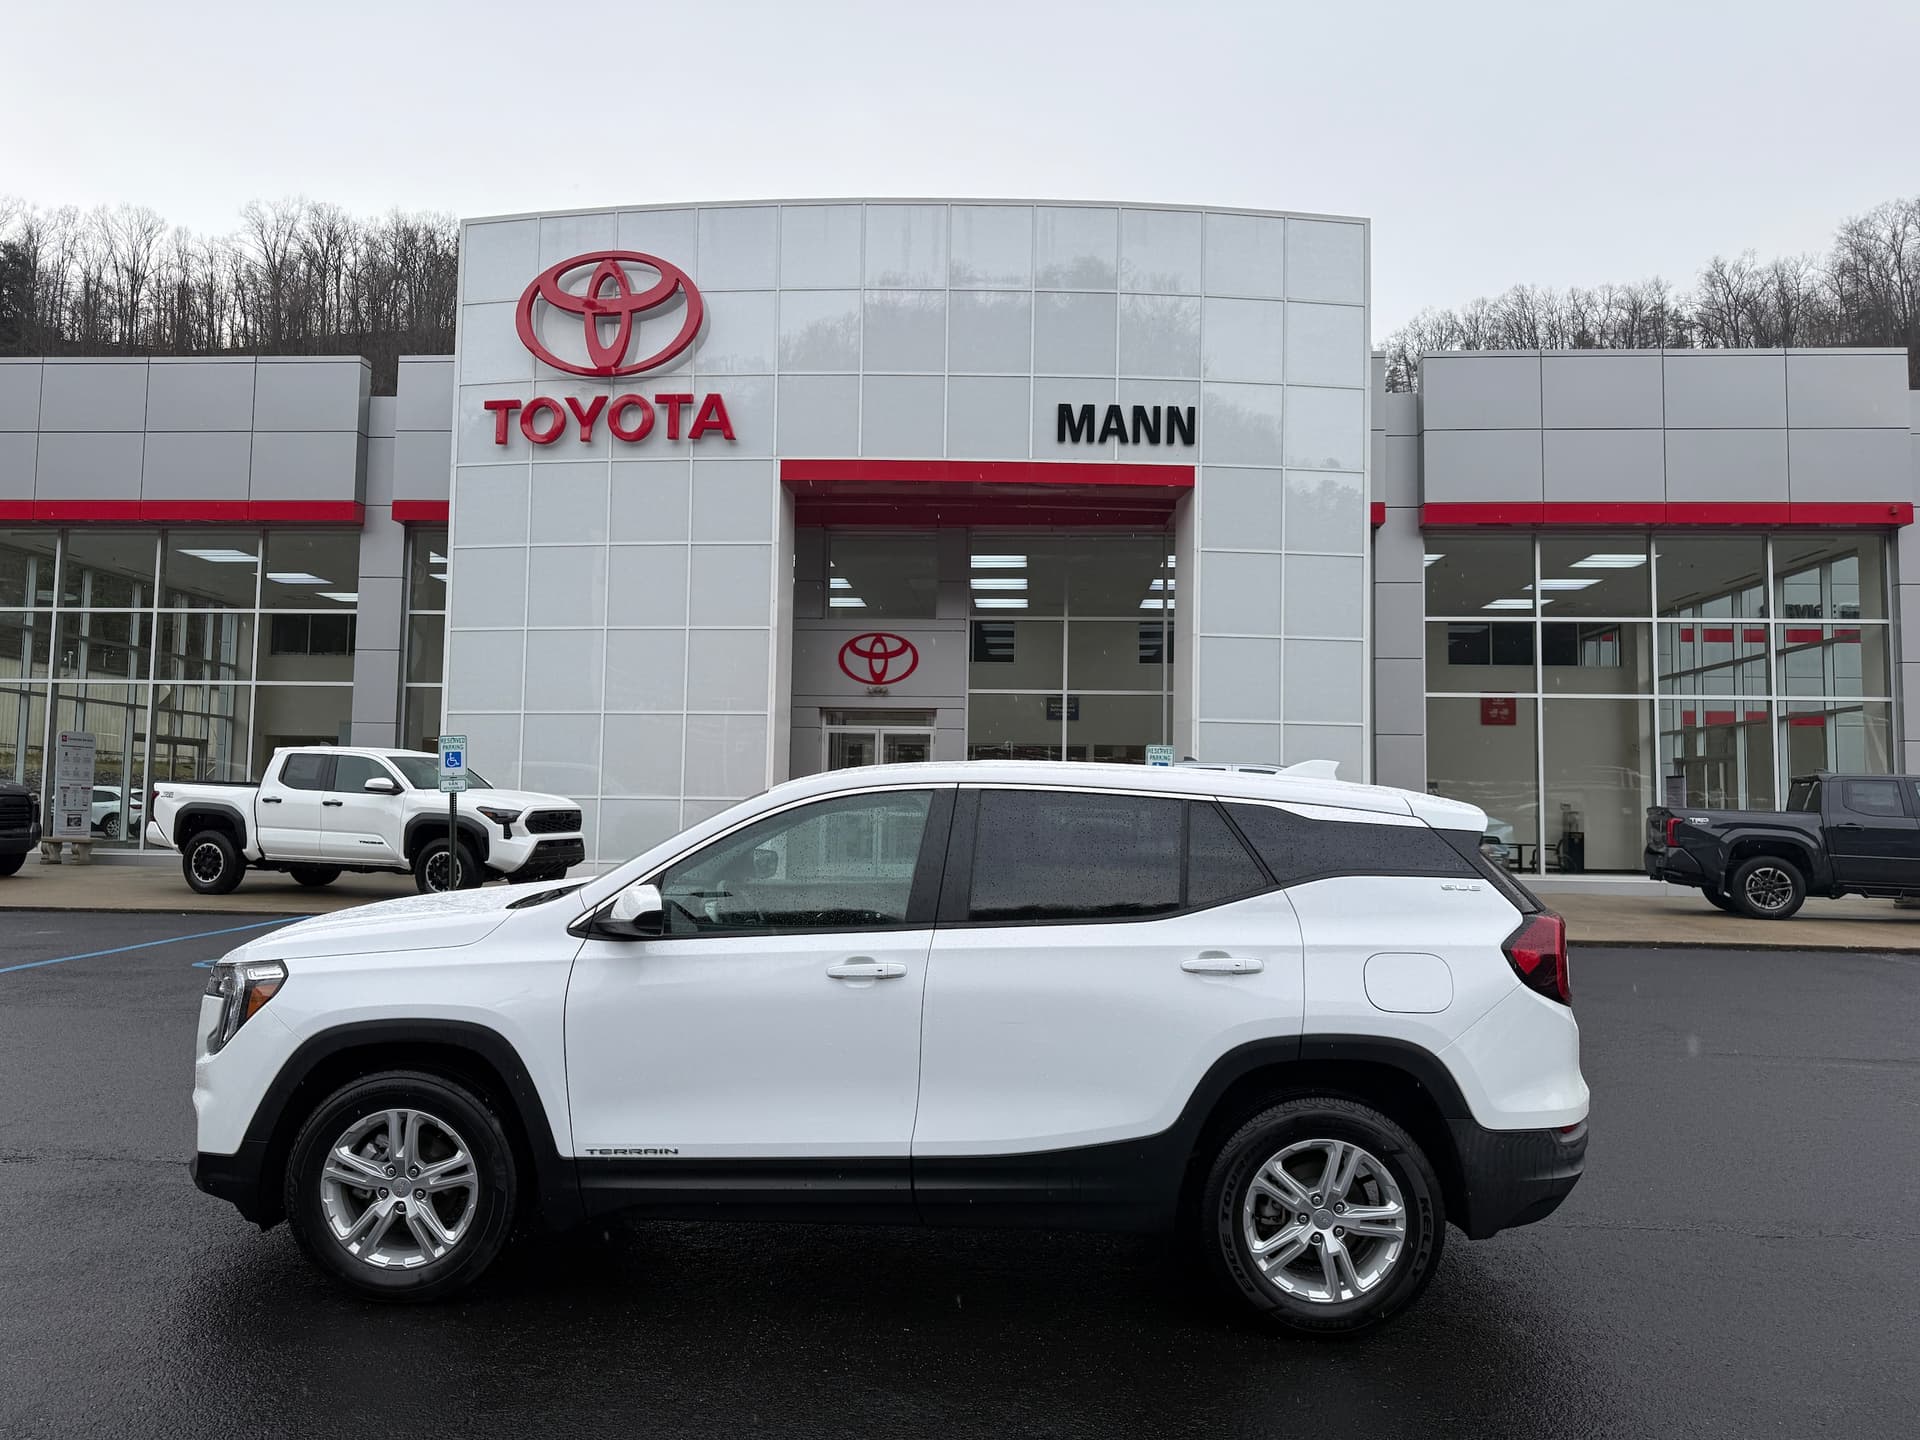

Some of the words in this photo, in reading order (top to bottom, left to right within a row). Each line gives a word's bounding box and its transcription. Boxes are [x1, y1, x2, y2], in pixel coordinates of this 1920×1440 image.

[484, 393, 736, 445] TOYOTA
[1057, 403, 1196, 445] MANN
[585, 1148, 679, 1156] TERRAIN
[1413, 1197, 1433, 1278] KELLY
